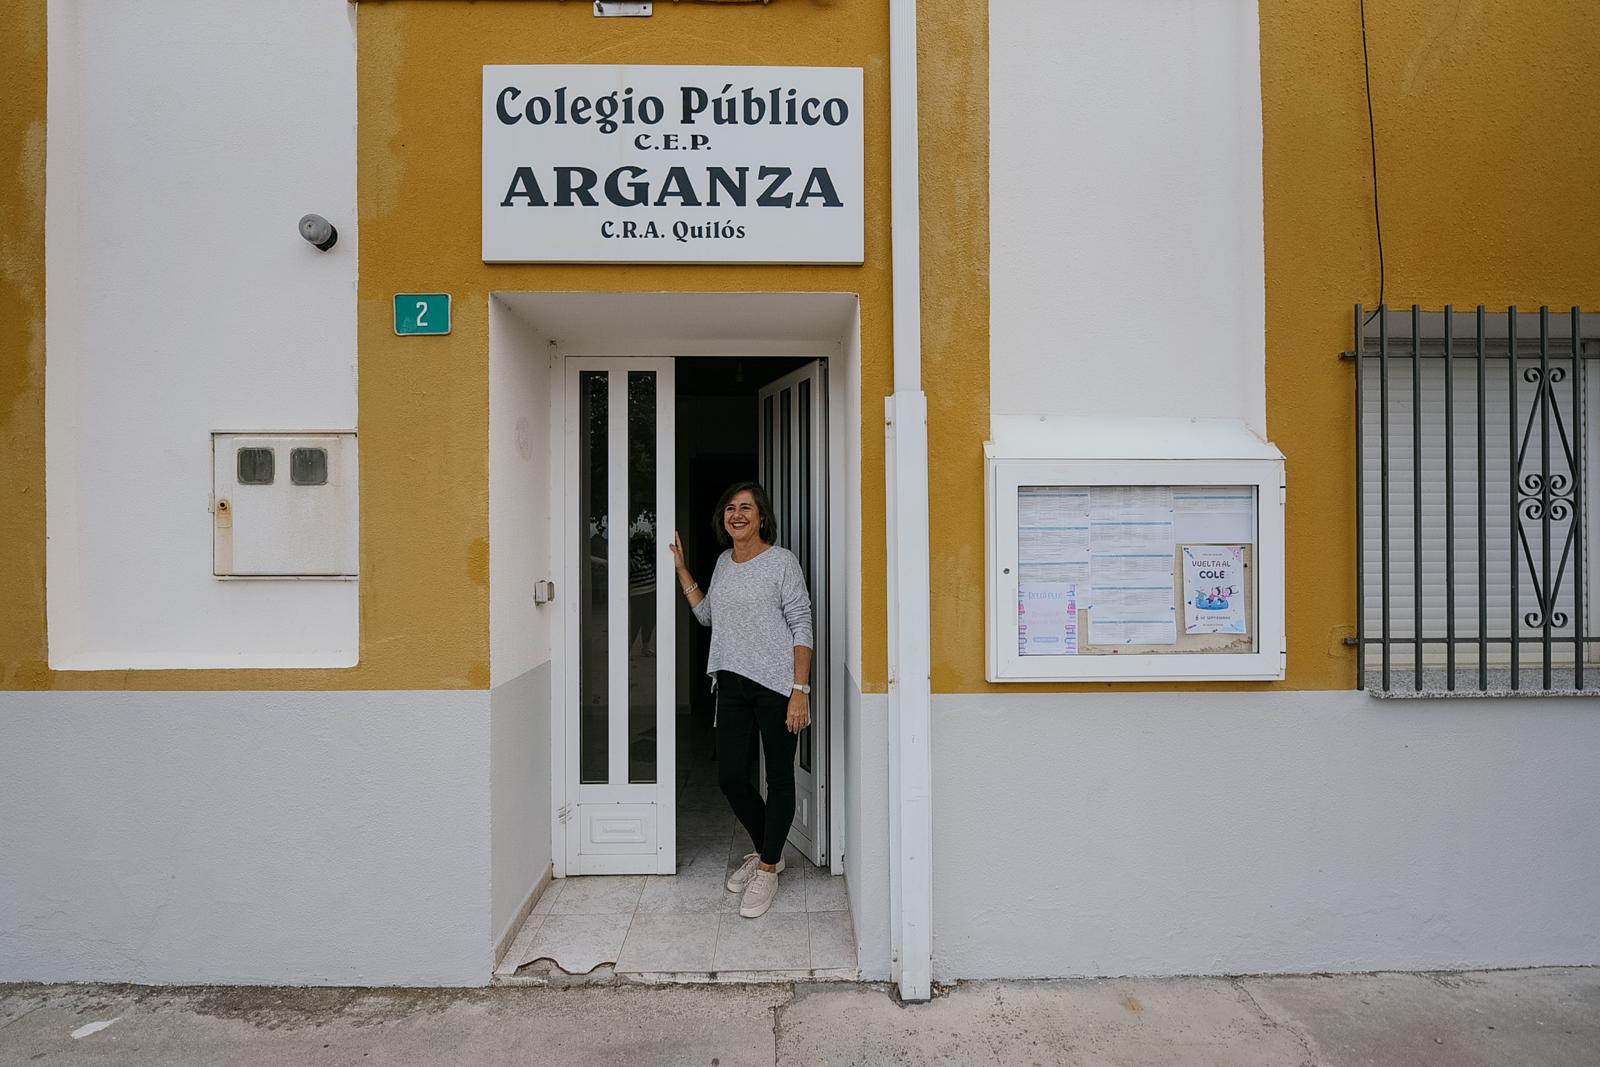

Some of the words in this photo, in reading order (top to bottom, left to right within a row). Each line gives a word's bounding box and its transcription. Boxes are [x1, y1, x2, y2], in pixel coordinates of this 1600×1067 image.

[495, 86, 665, 134] Colegio
[680, 83, 849, 126] Público
[634, 134, 712, 151] C.E.P.
[500, 165, 844, 208] ARGANZA
[601, 220, 665, 239] C.R.A.
[672, 219, 746, 242] Quilós
[416, 301, 428, 327] 2
[1199, 570, 1225, 579] COLE
